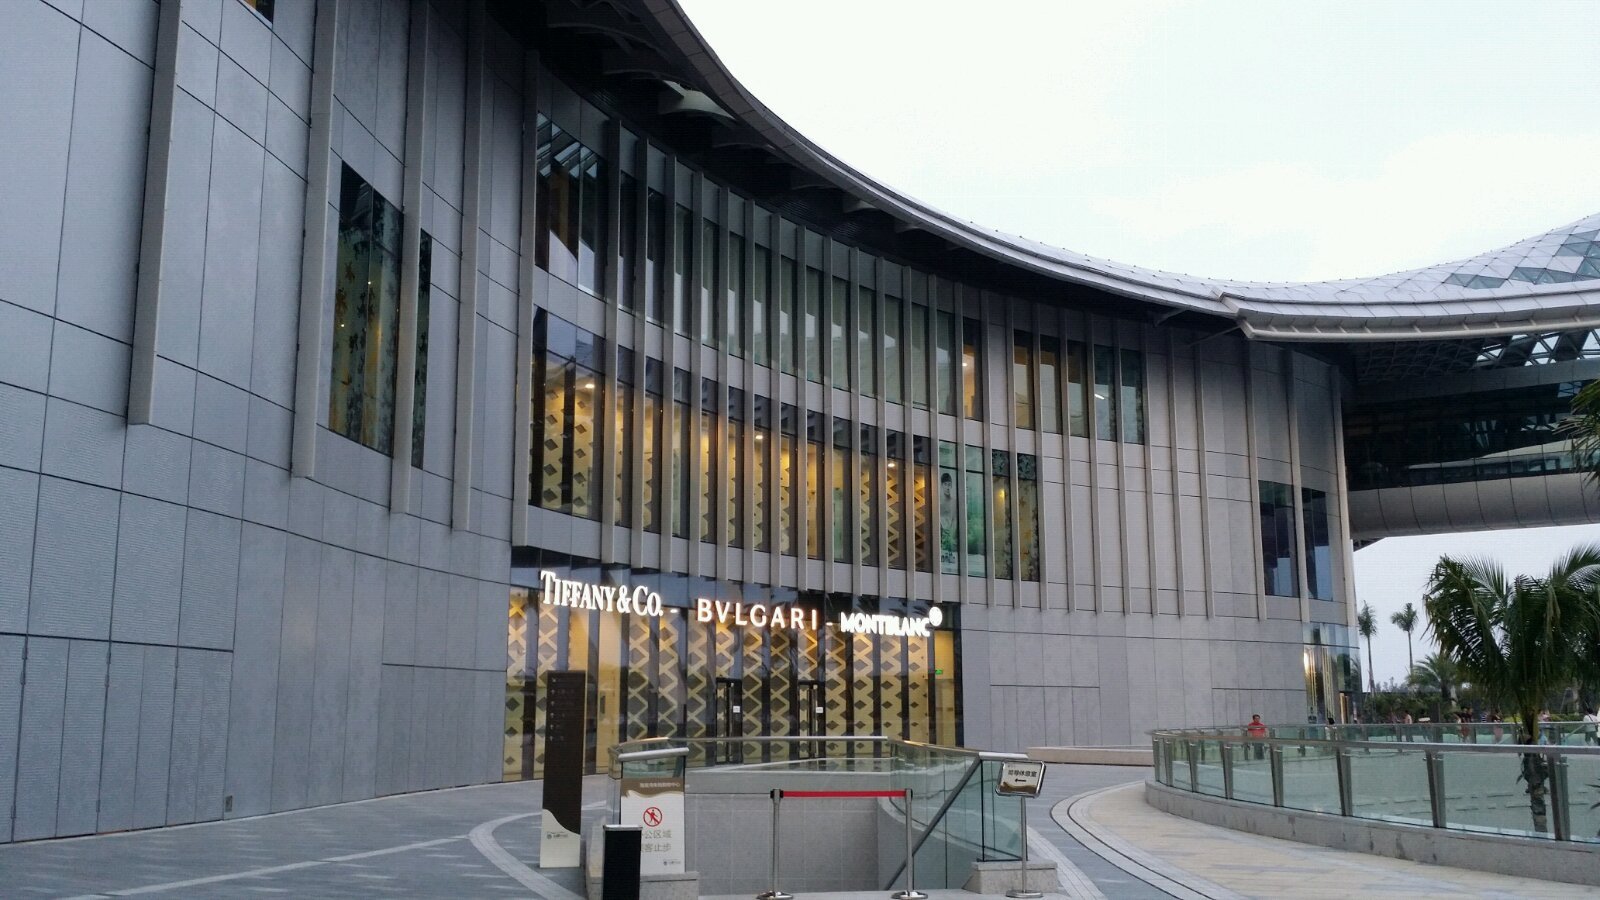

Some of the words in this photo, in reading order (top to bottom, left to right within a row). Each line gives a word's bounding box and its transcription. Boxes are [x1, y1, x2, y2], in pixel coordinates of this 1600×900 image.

[697, 598, 818, 631] BVLGARI
[840, 611, 931, 637] MONTBLANC
[641, 829, 672, 839] 公区域
[641, 843, 672, 852] 客止步
